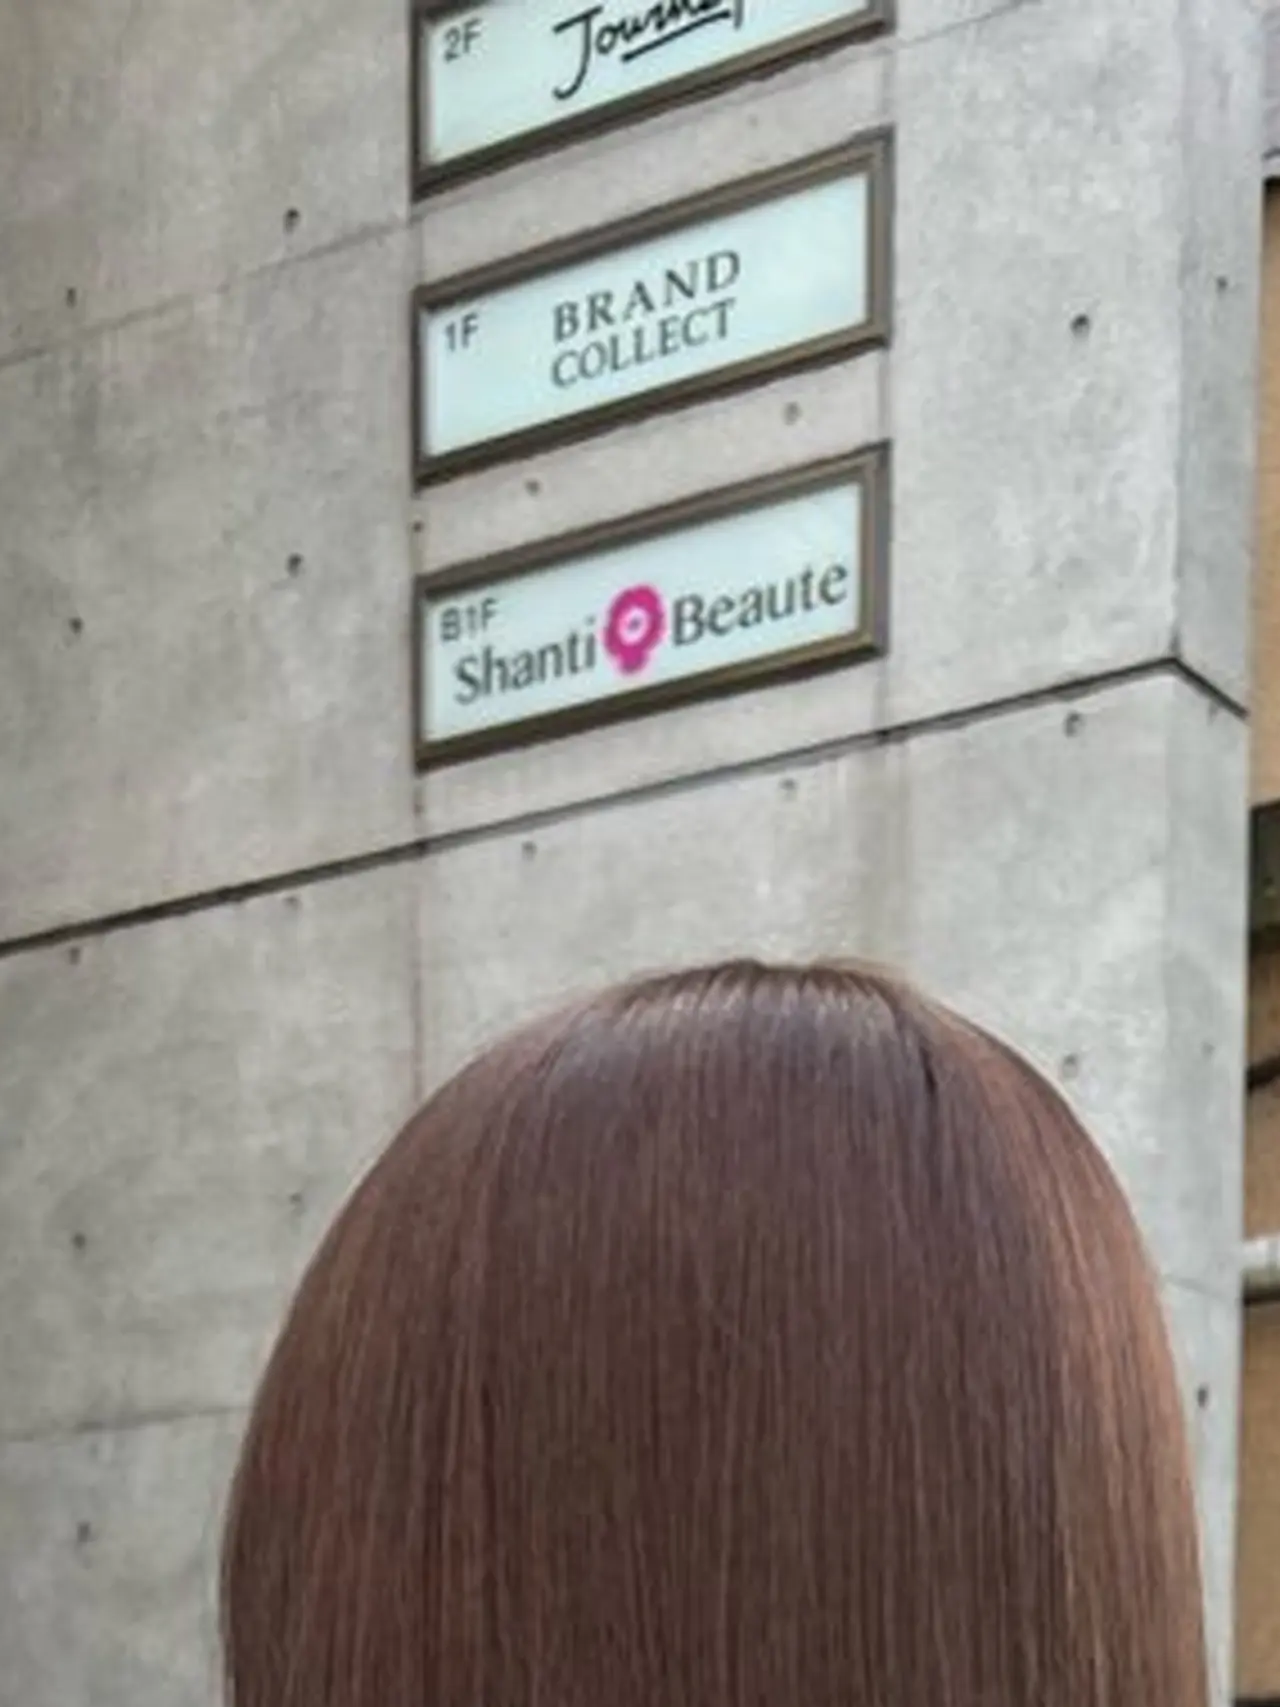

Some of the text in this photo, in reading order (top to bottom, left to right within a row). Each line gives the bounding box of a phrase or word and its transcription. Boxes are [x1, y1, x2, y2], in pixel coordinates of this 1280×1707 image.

[442, 17, 484, 62] 2F
[552, 250, 741, 342] BRAND
[444, 311, 479, 352] 1F
[550, 297, 737, 388] COLLECT
[439, 597, 499, 643] B1F
[453, 562, 849, 705] Shanti Beaute
